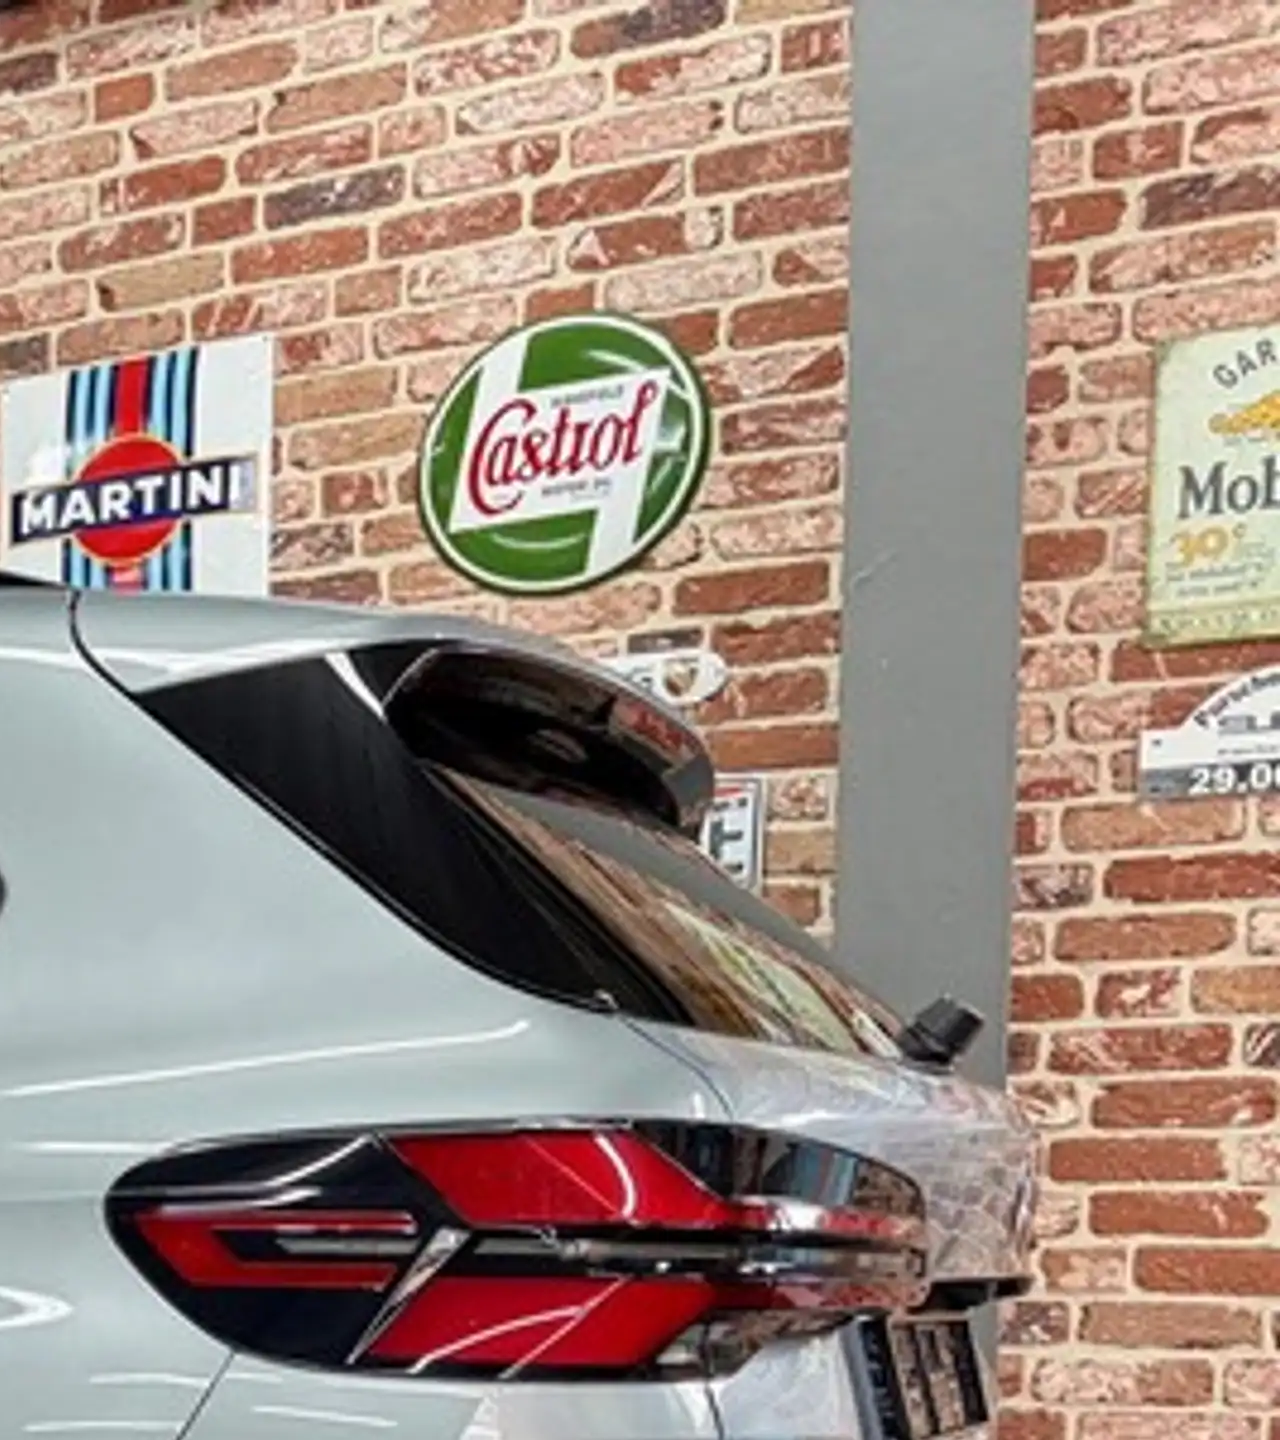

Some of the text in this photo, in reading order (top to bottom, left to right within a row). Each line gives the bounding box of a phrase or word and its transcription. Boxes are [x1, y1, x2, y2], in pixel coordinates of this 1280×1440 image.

[468, 380, 658, 517] Castrol
[20, 464, 240, 535] MARTINI
[1188, 763, 1280, 796] 29.0
